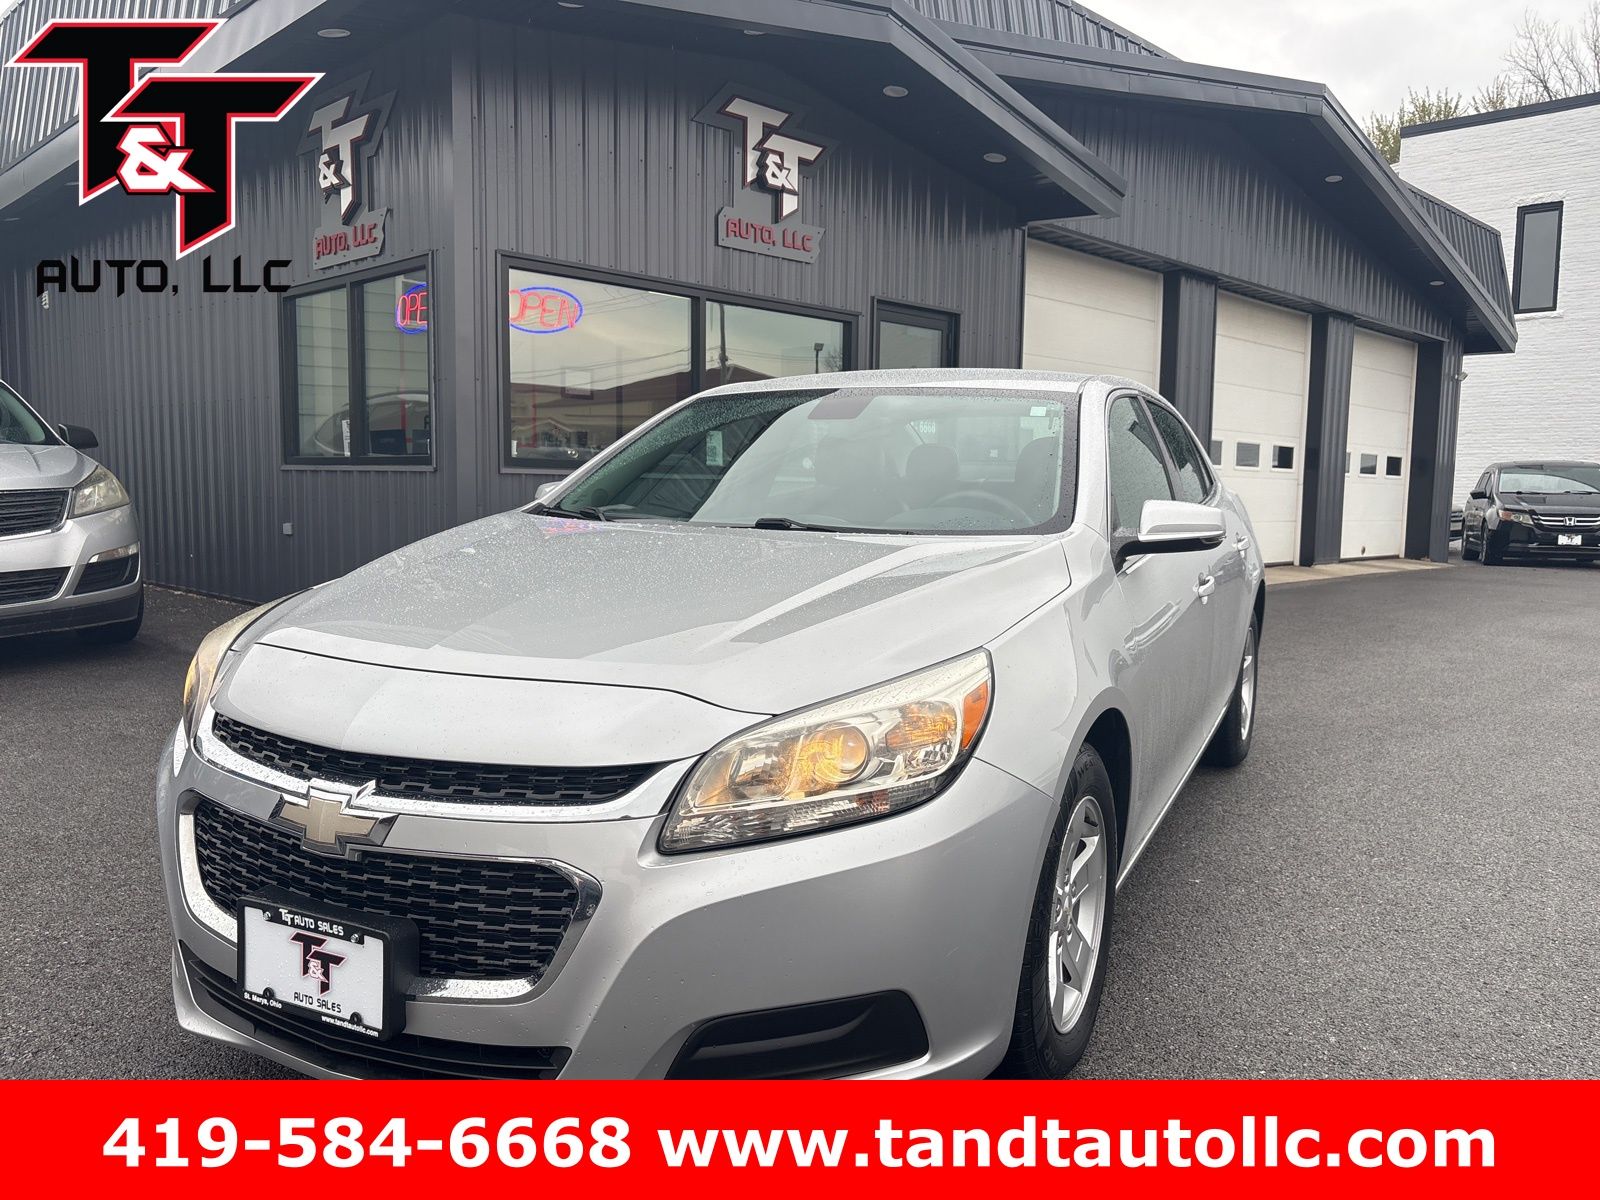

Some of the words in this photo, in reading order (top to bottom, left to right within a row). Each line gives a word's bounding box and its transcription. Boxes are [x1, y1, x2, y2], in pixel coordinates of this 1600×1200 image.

[315, 231, 350, 260] AUTO,
[352, 223, 378, 247] LLC
[726, 218, 777, 248] AUTO,
[782, 227, 813, 252] LLC
[398, 291, 428, 326] OPE
[508, 289, 579, 329] OPEN
[294, 914, 315, 929] AUTO
[317, 920, 344, 936] SALES
[269, 999, 283, 1009] Ohio
[293, 991, 314, 1006] AUTO
[316, 998, 342, 1013] SALES
